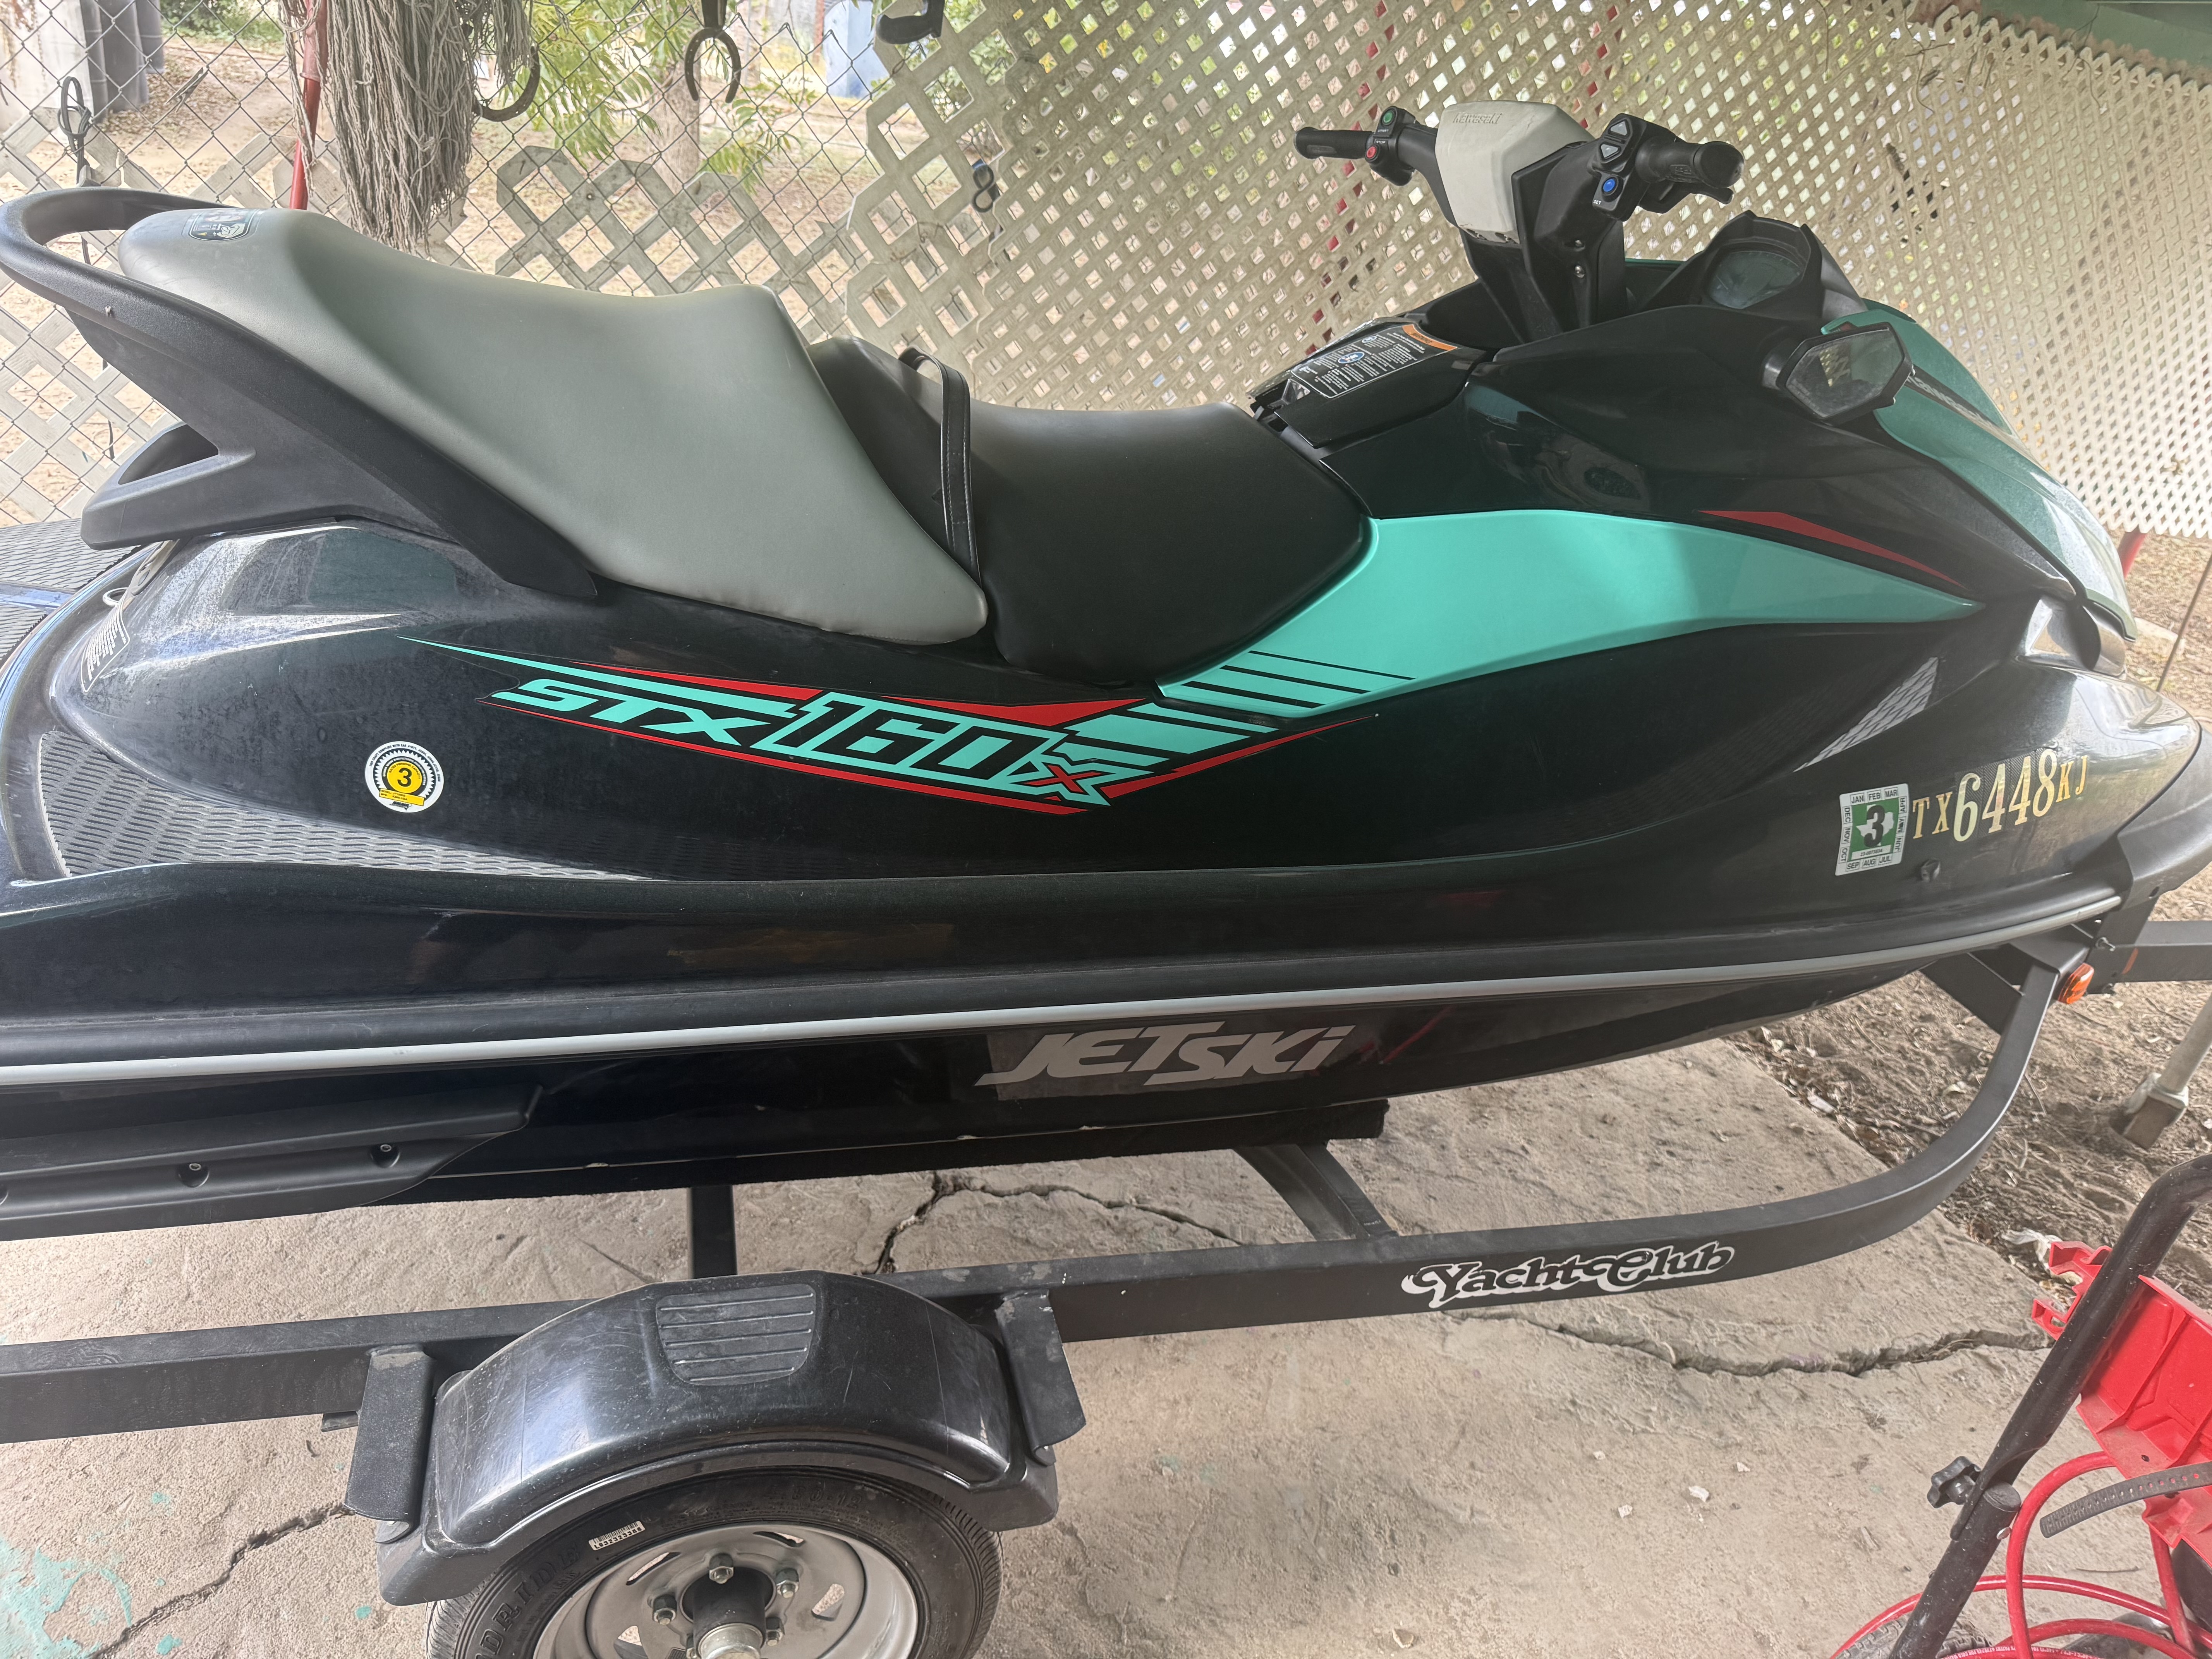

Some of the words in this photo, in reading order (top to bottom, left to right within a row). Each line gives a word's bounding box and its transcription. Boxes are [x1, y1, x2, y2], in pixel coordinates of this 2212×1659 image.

[1453, 112, 1503, 124] Kawasaki
[397, 767, 412, 787] 3
[1868, 792, 1881, 800] FEB
[1885, 789, 1898, 797] MAR
[1953, 749, 2057, 842] 6448
[1863, 805, 1885, 848] 3
[1847, 862, 1860, 870] SEP
[1403, 1257, 1583, 1307] Yacht
[1583, 1241, 1735, 1291] Club
